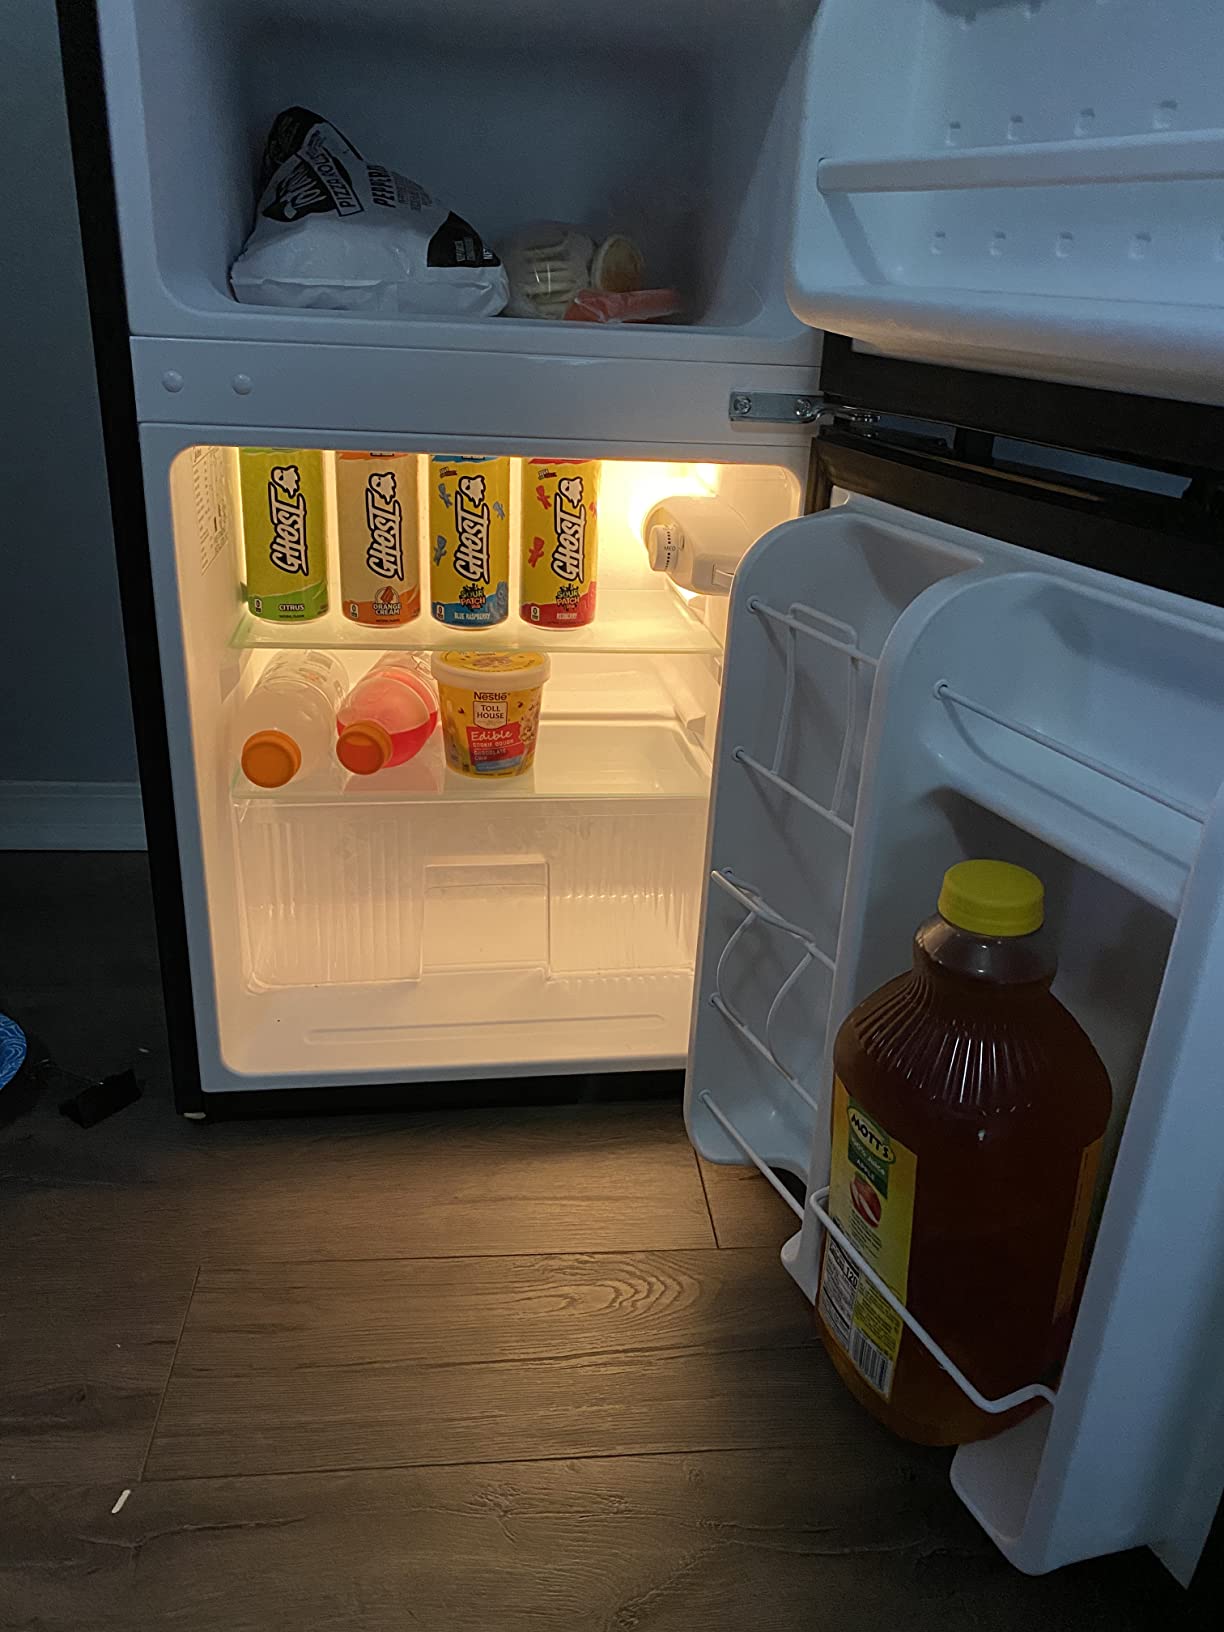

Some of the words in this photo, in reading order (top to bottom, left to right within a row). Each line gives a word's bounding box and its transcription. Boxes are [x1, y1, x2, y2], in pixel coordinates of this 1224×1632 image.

[327, 178, 355, 208] PIZZA
[268, 481, 309, 576] GHOST
[365, 487, 404, 581] GHOST
[453, 490, 490, 585] GHOST
[551, 492, 587, 584] GHOST
[461, 590, 483, 598] SOUR
[558, 590, 578, 598] SOUR
[460, 597, 486, 606] PATCH
[556, 597, 580, 606] PATCH
[481, 704, 501, 712] TOLL
[471, 730, 513, 741] Edible
